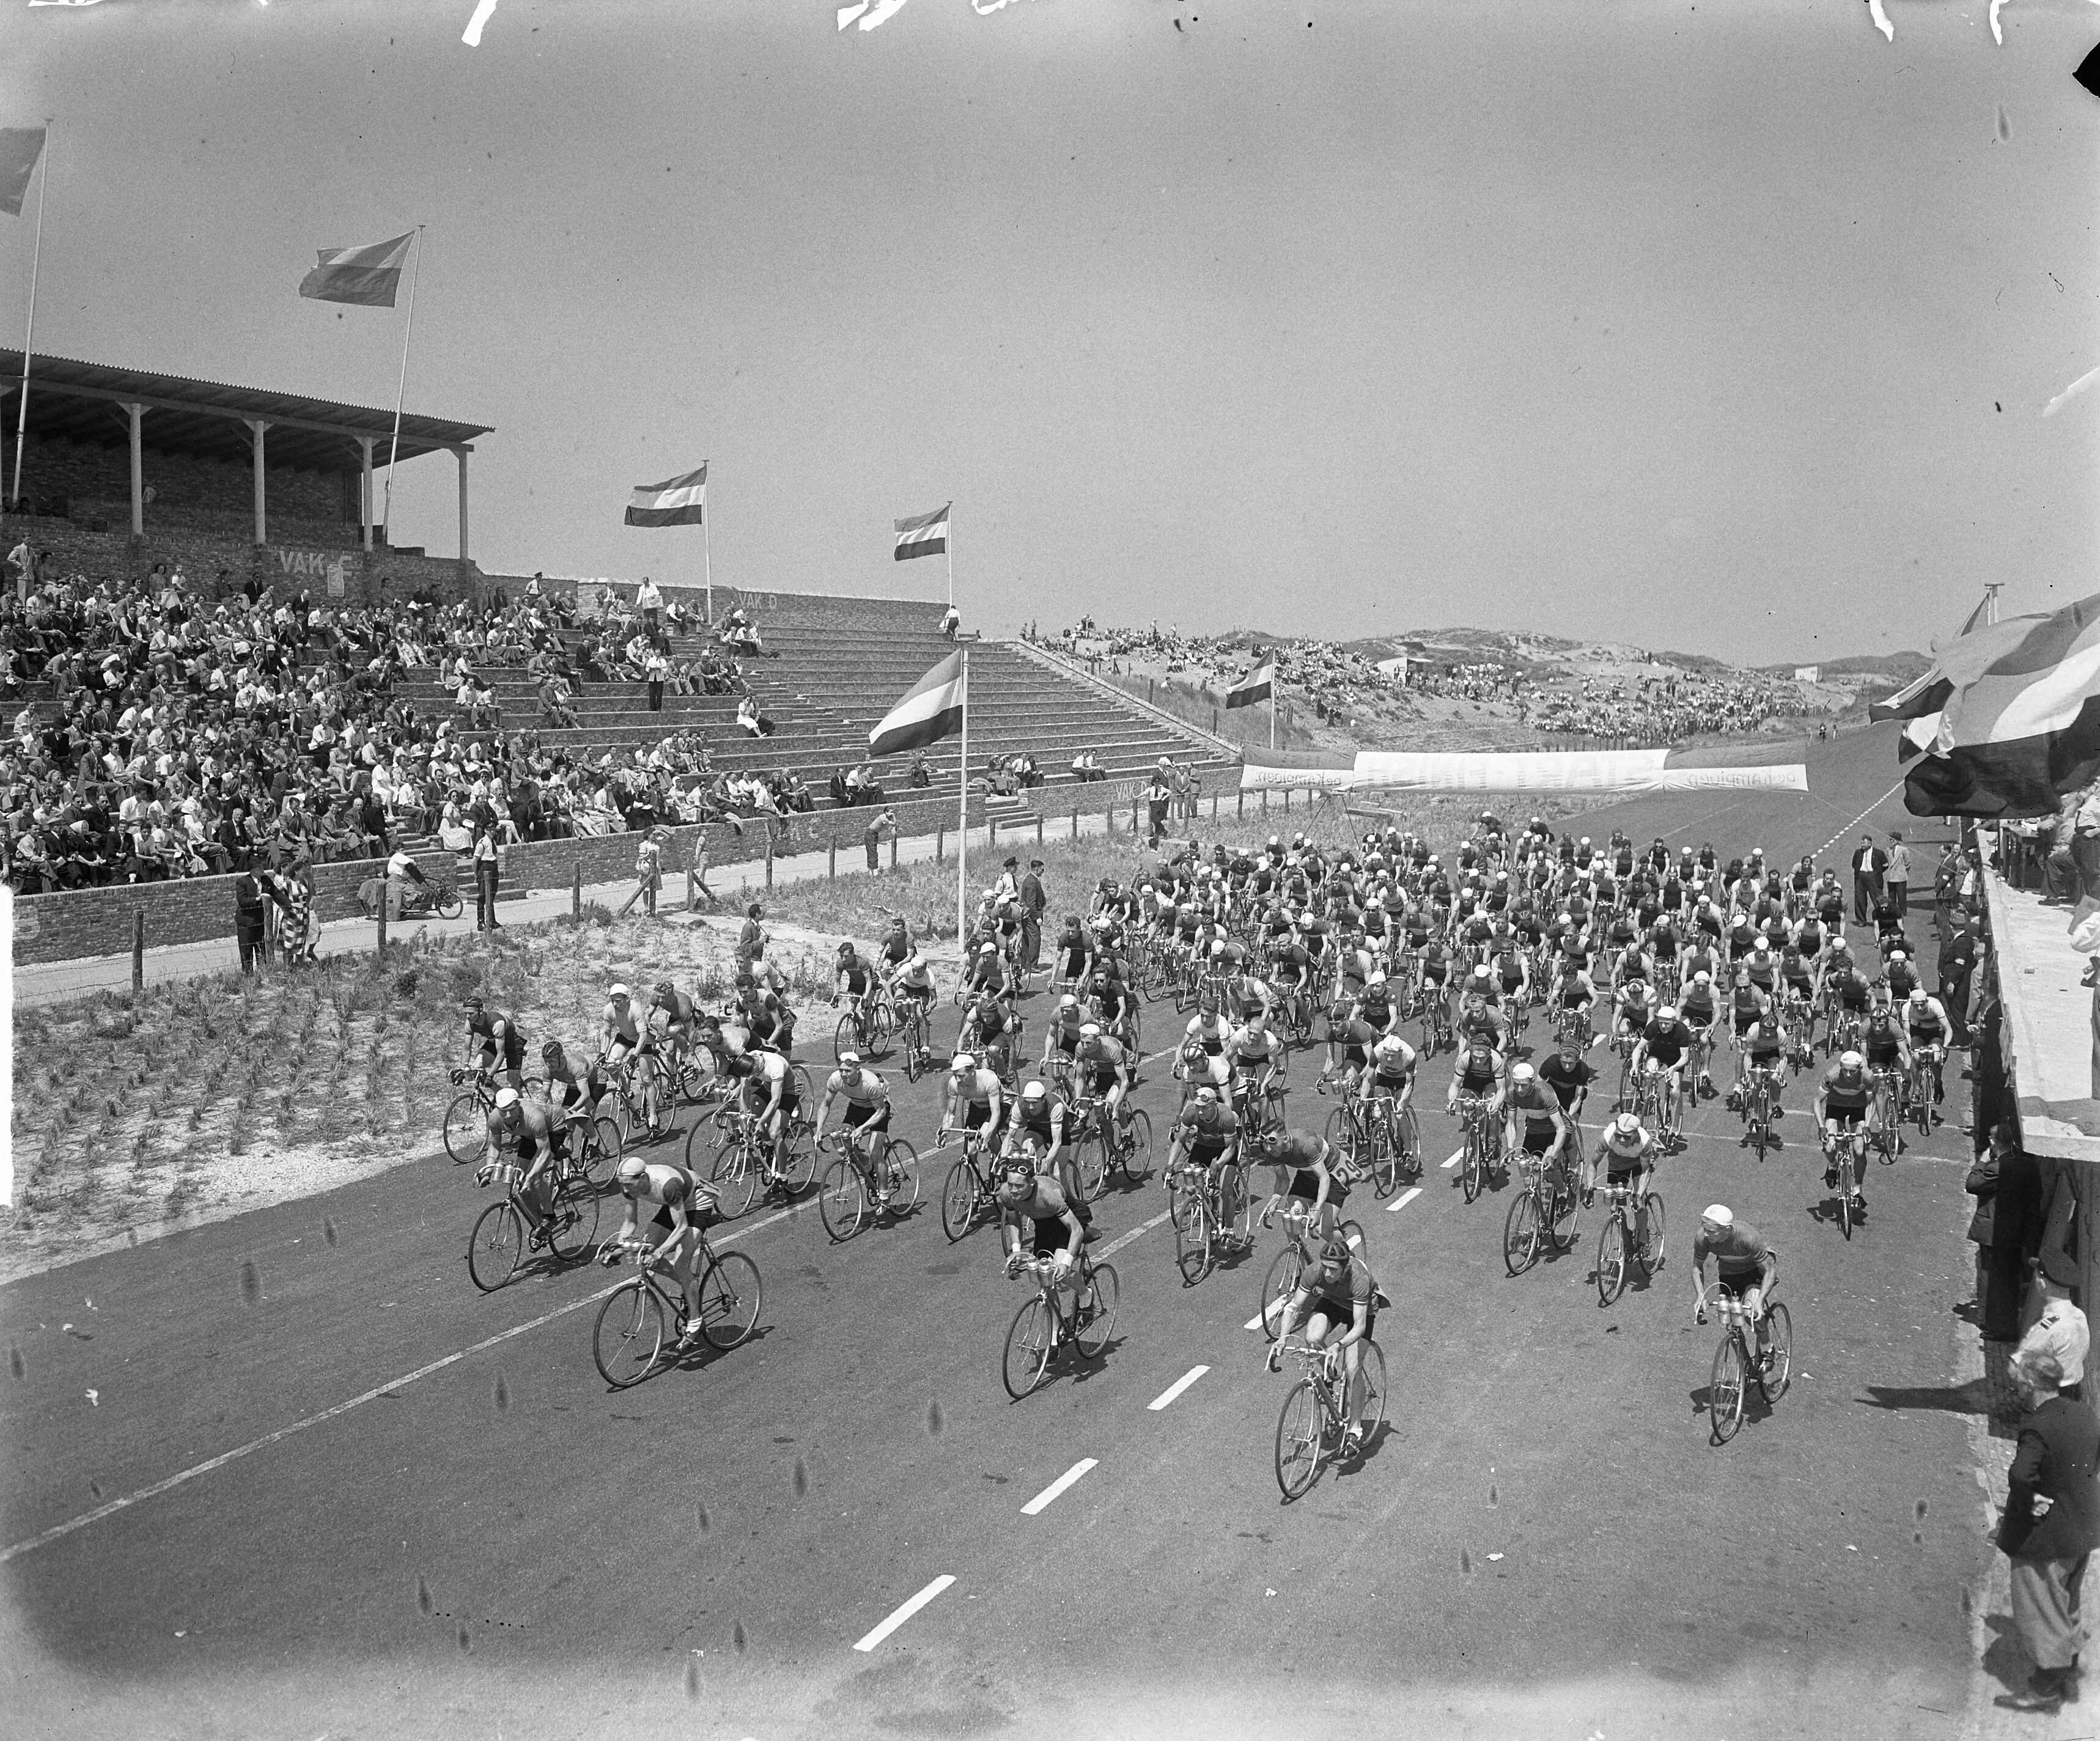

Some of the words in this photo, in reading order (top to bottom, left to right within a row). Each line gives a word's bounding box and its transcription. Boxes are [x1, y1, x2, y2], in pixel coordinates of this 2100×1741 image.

[279, 550, 325, 576] VAK
[738, 592, 762, 609] VAK
[768, 594, 778, 609] D
[1115, 782, 1136, 801] VAK
[1336, 1159, 1363, 1188] 29
